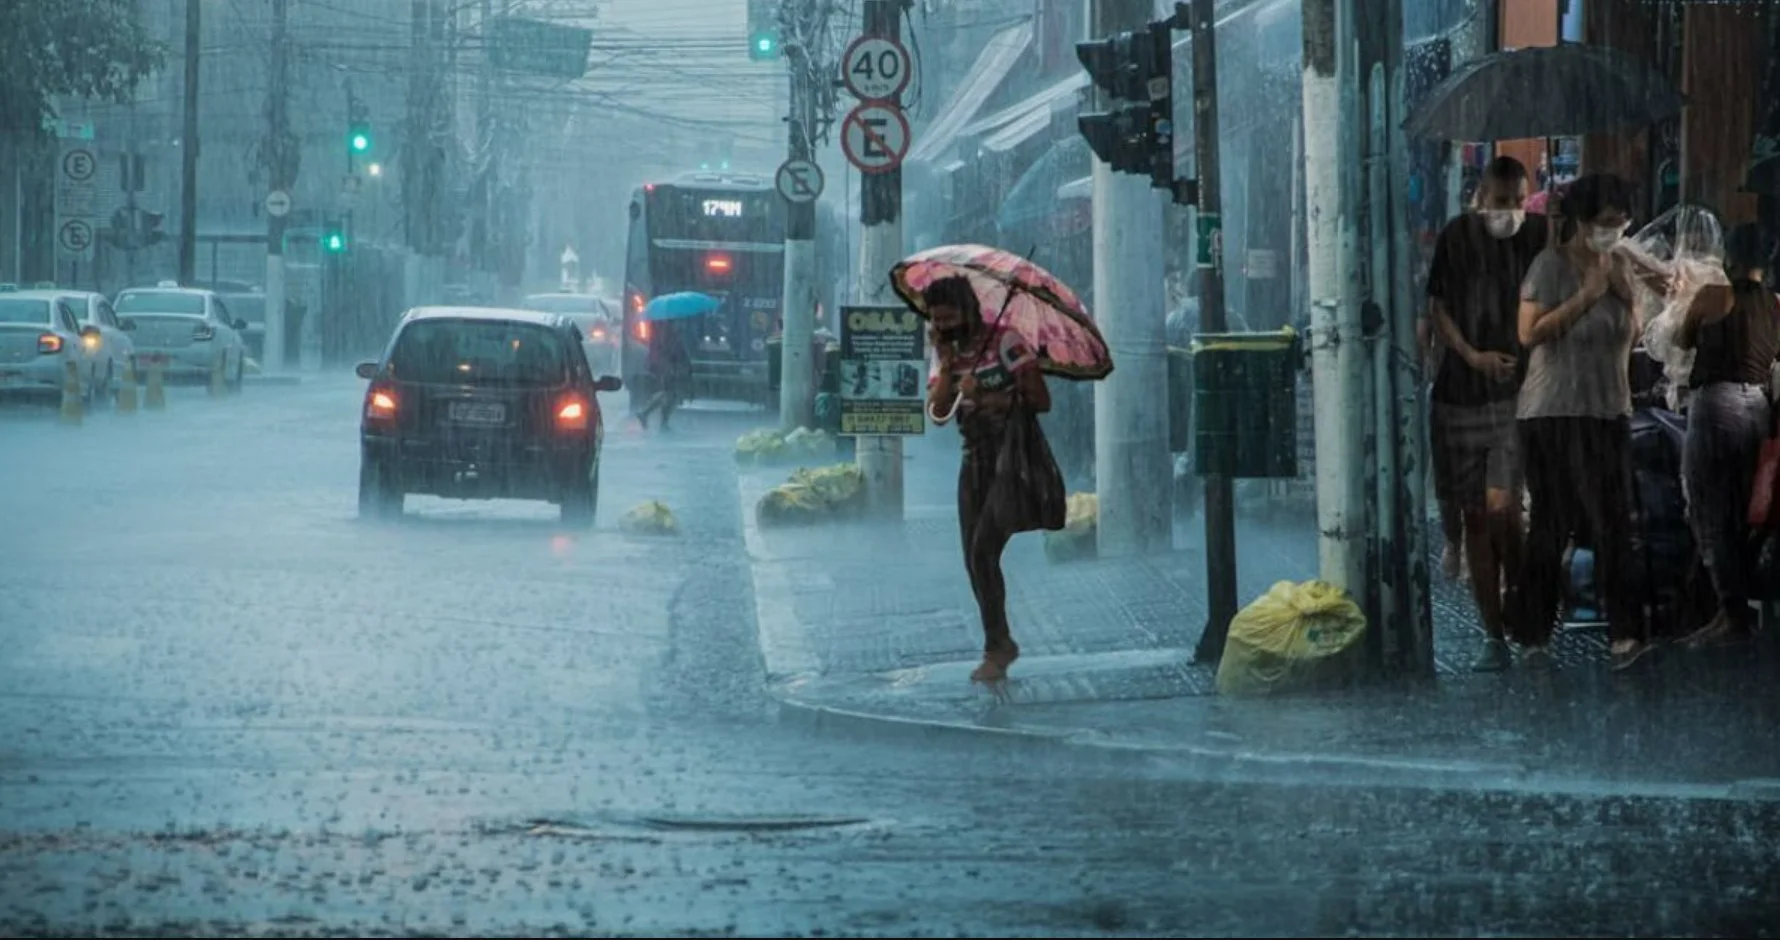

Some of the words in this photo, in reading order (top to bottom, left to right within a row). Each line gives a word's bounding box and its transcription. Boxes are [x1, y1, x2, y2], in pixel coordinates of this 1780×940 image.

[852, 49, 899, 79] 40
[863, 118, 887, 157] E
[74, 156, 86, 174] E
